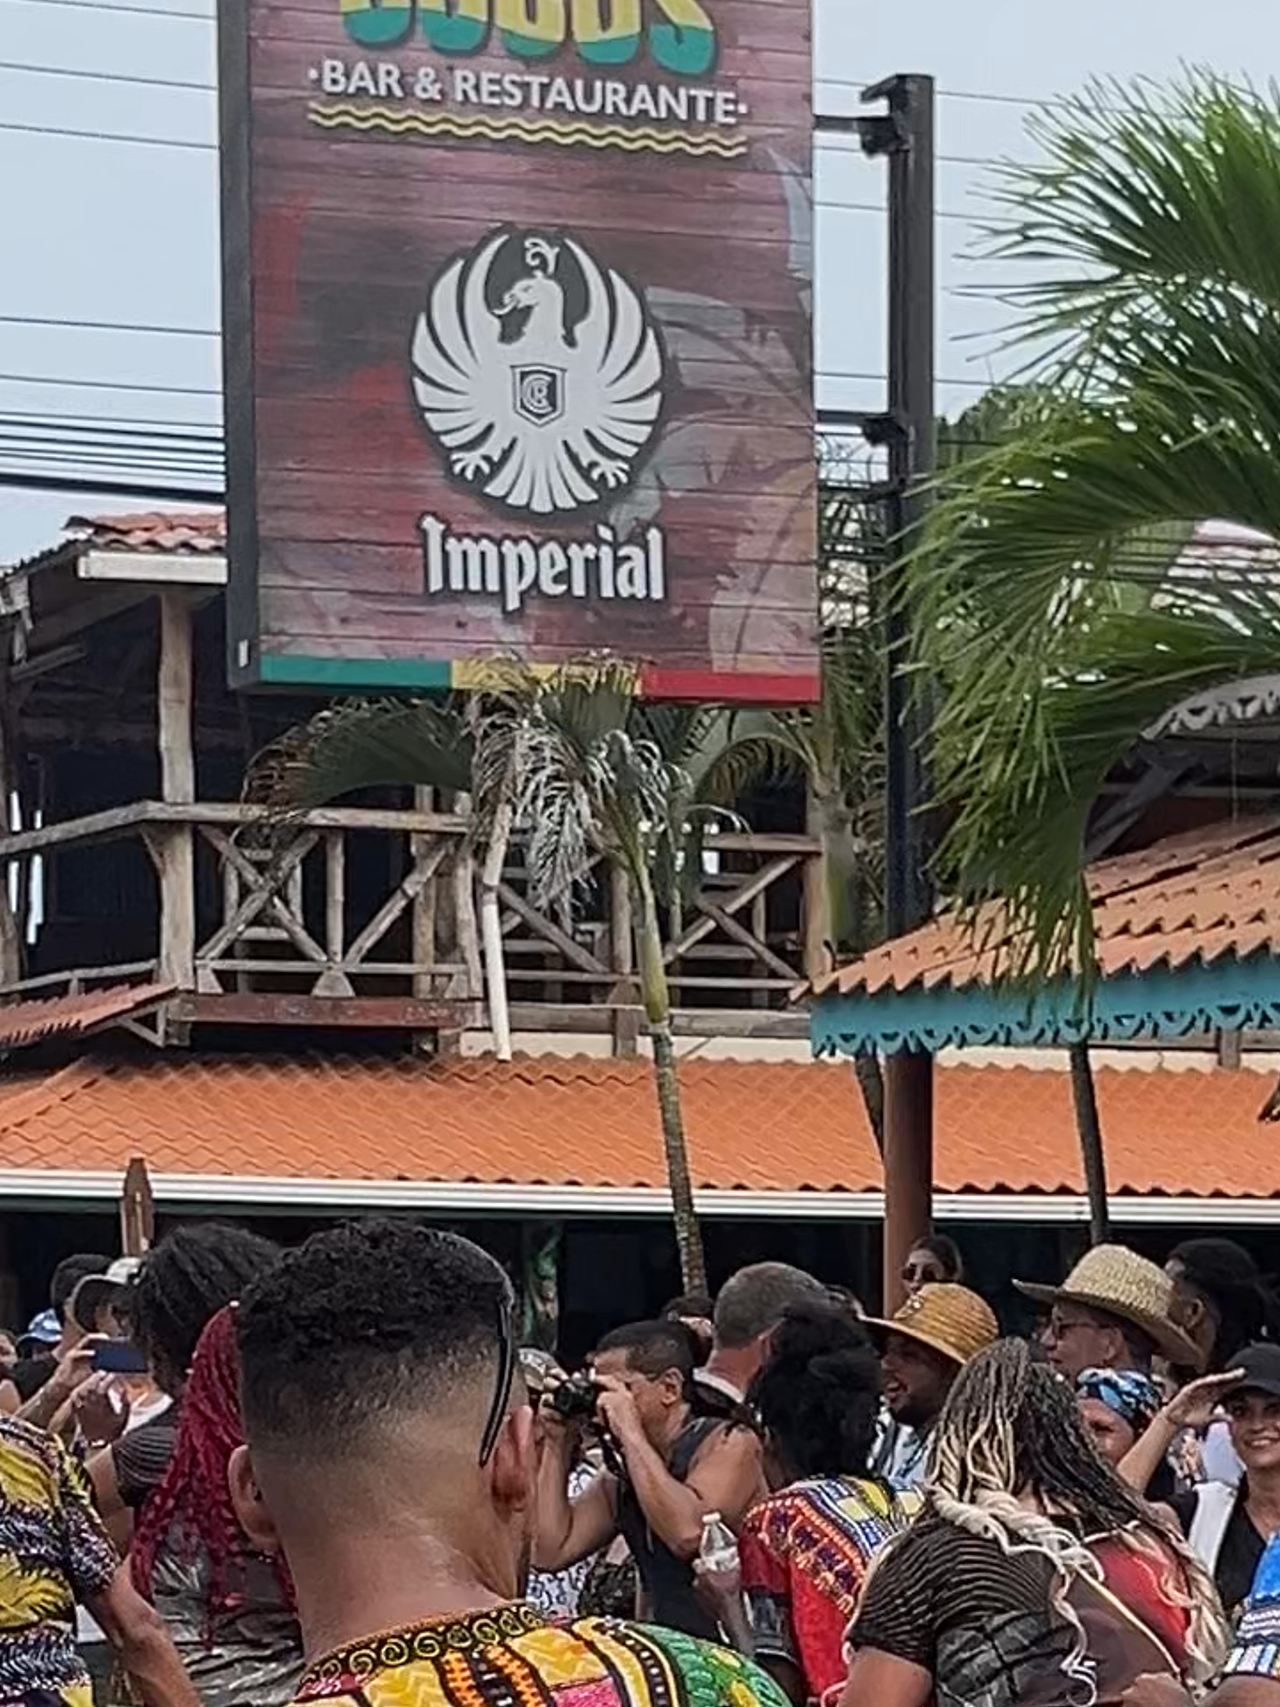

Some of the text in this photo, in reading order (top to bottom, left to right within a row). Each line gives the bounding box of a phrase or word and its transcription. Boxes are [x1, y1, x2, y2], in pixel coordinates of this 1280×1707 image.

[322, 59, 738, 125] BAR & RESTAURANTE
[421, 514, 665, 612] Imperial
